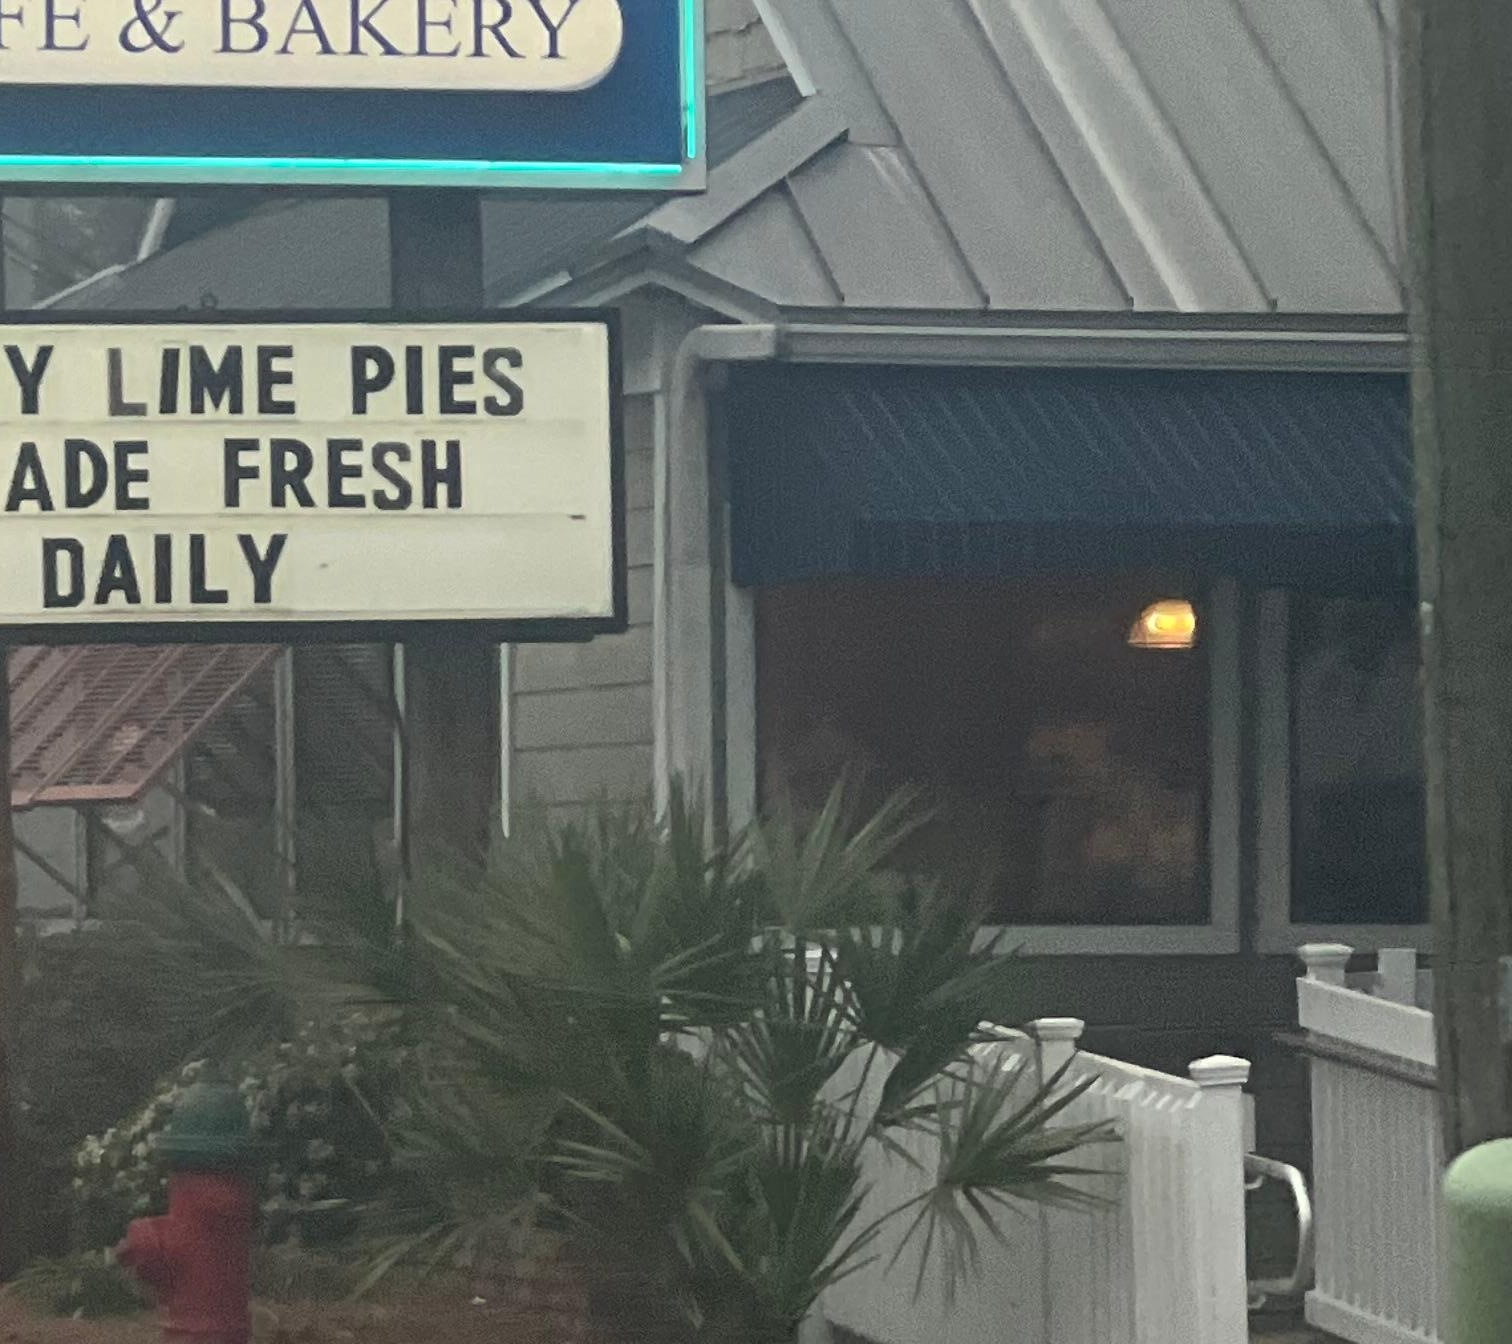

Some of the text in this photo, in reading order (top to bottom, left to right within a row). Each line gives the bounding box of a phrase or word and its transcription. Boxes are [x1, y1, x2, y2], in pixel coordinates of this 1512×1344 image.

[107, 345, 297, 418] LIME
[351, 344, 525, 417] PIES
[223, 438, 463, 511] FRESH
[41, 533, 289, 609] DAILY
